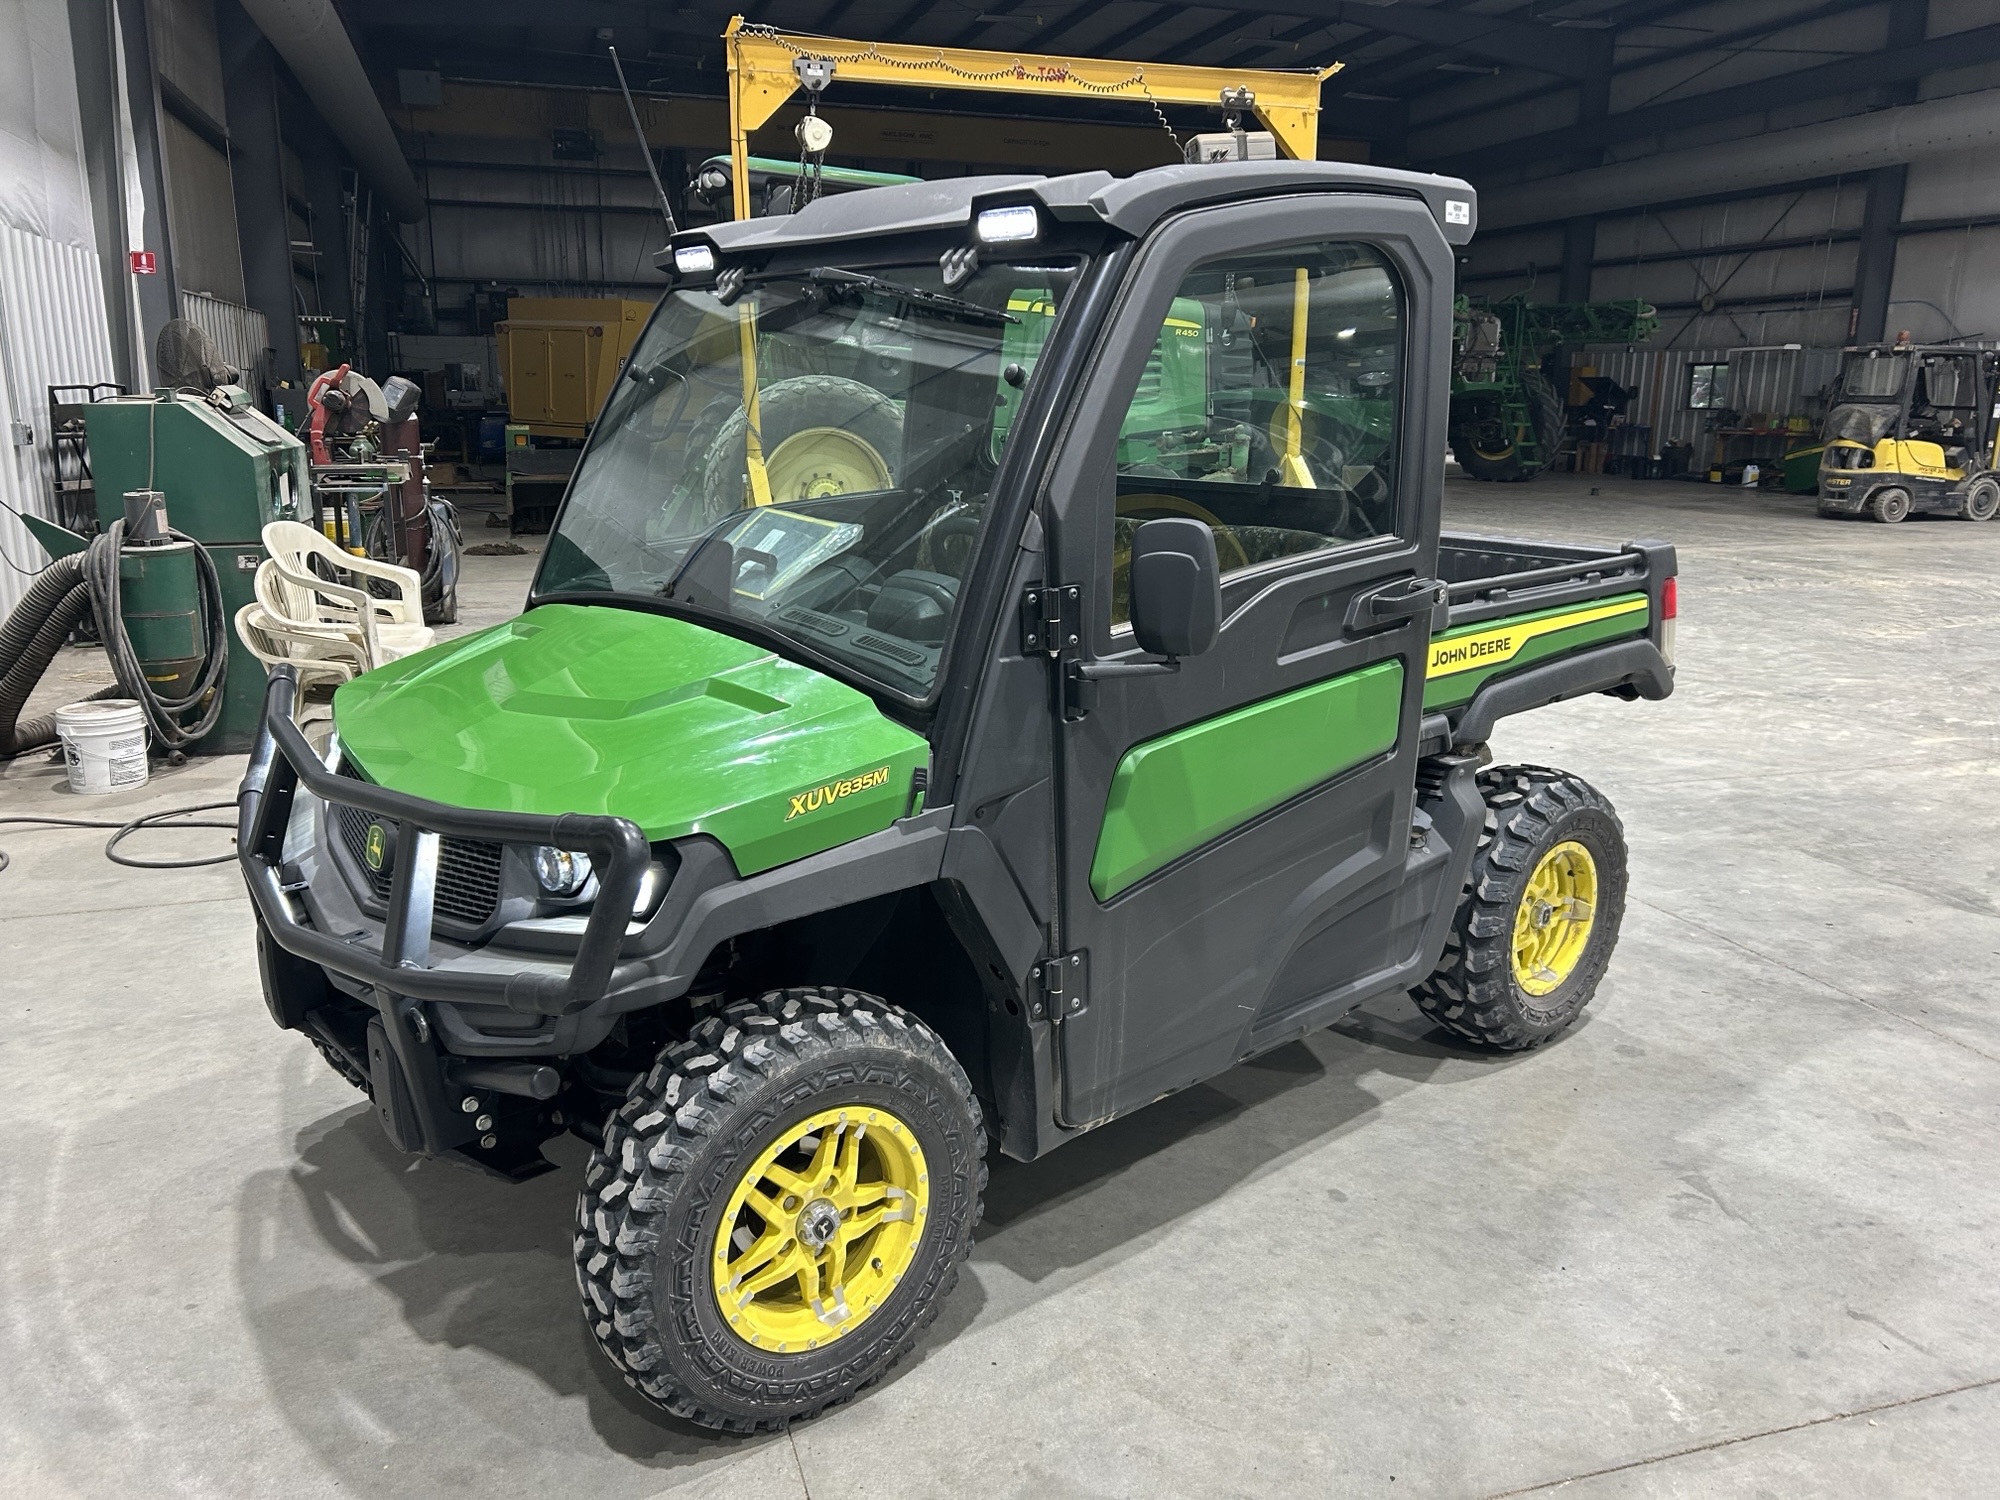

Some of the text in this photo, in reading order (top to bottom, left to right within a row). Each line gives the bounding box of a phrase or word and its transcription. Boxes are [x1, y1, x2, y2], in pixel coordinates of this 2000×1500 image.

[1038, 66, 1065, 83] TON
[1175, 329, 1199, 337] R450
[1432, 637, 1511, 667] JOHN DEERE
[785, 767, 889, 820] XUV835M
[711, 1329, 785, 1377] POWER KING
